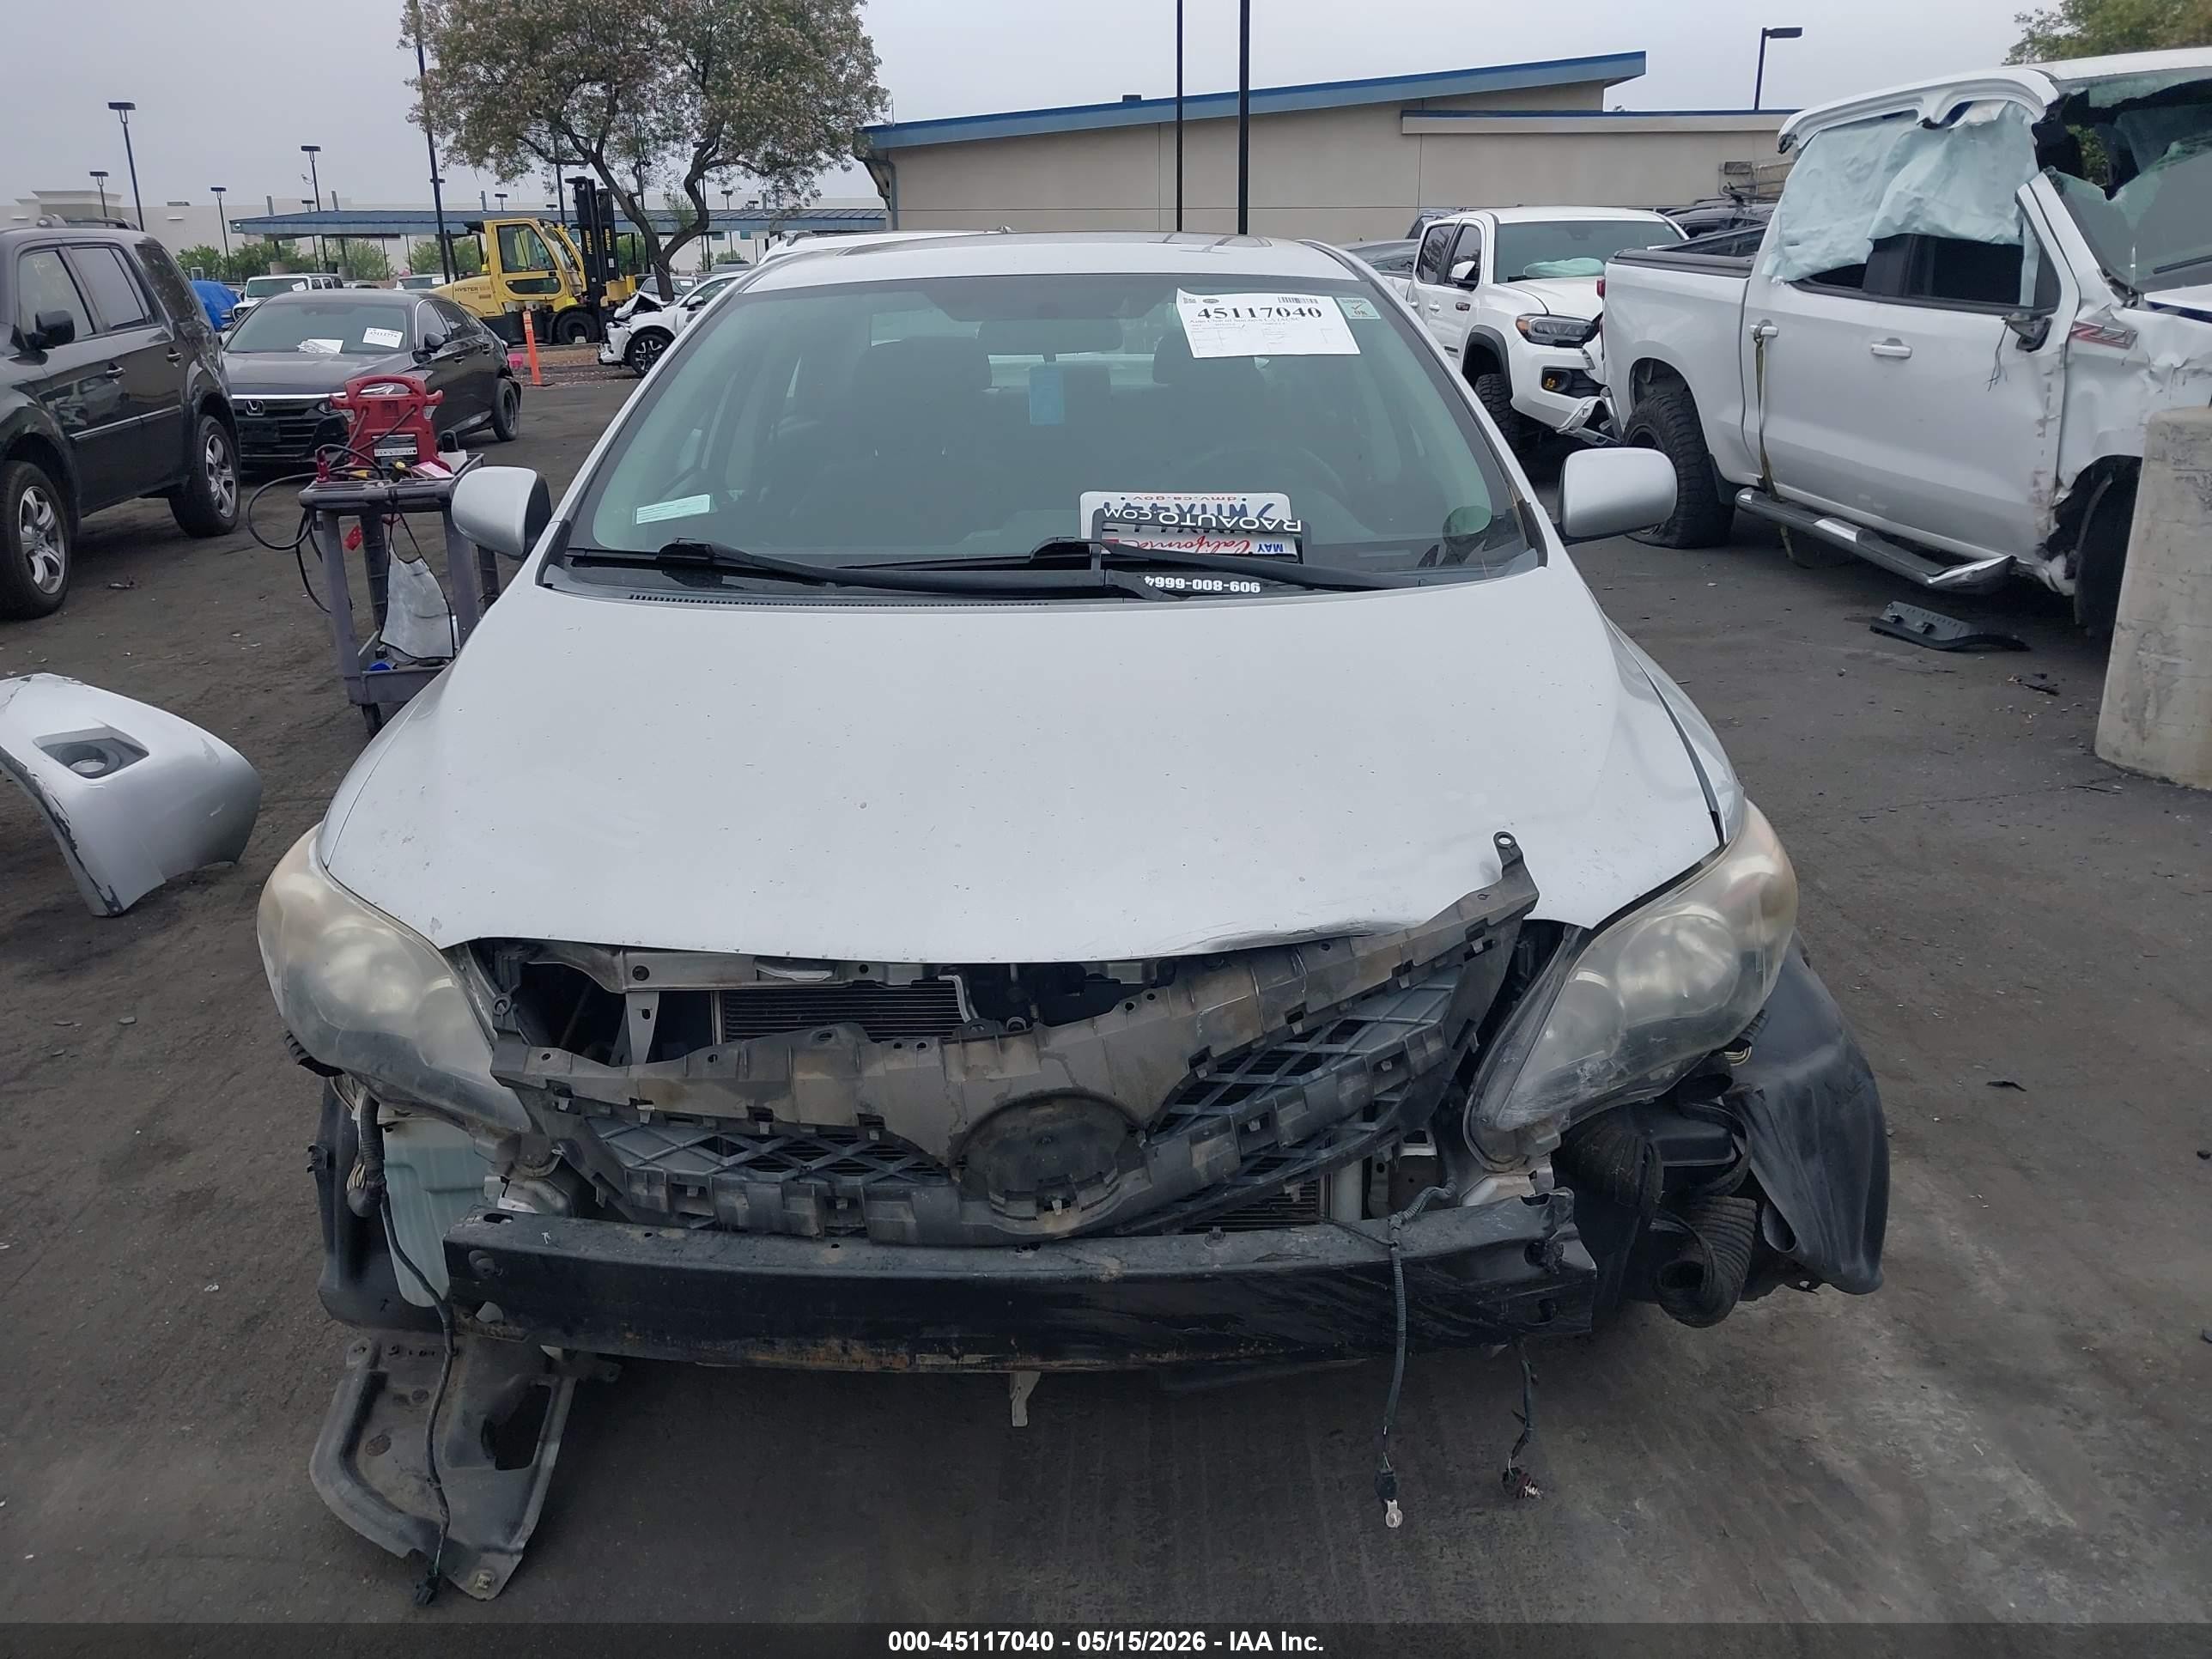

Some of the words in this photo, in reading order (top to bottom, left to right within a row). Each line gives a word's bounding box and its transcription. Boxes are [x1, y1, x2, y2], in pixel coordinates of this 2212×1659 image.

[1197, 307, 1322, 319] 45117040
[1103, 507, 1303, 532] RAOAUTO.COM
[1256, 543, 1284, 553] MAY
[1144, 575, 1261, 593] 909-800-6664
